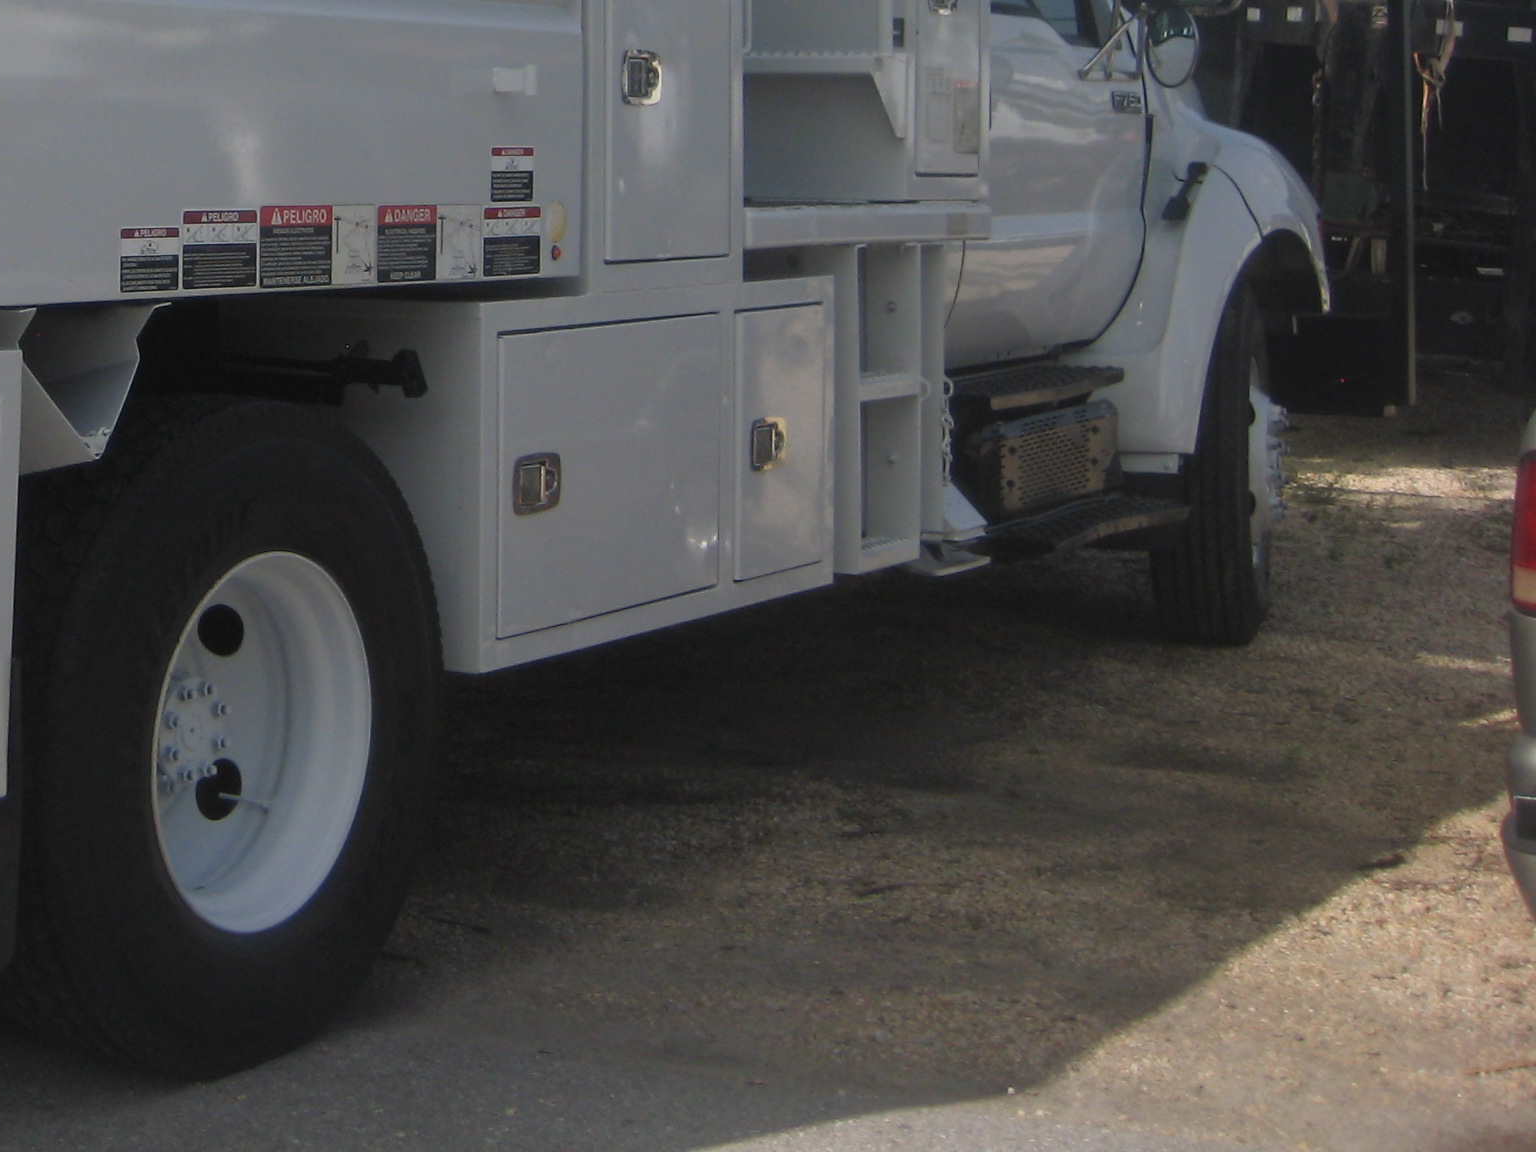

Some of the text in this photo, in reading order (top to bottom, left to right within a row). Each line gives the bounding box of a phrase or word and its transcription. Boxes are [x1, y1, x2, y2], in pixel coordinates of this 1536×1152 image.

[208, 212, 239, 222] PELIGRO
[284, 209, 327, 224] PELIGRO
[394, 209, 431, 222] DANGER
